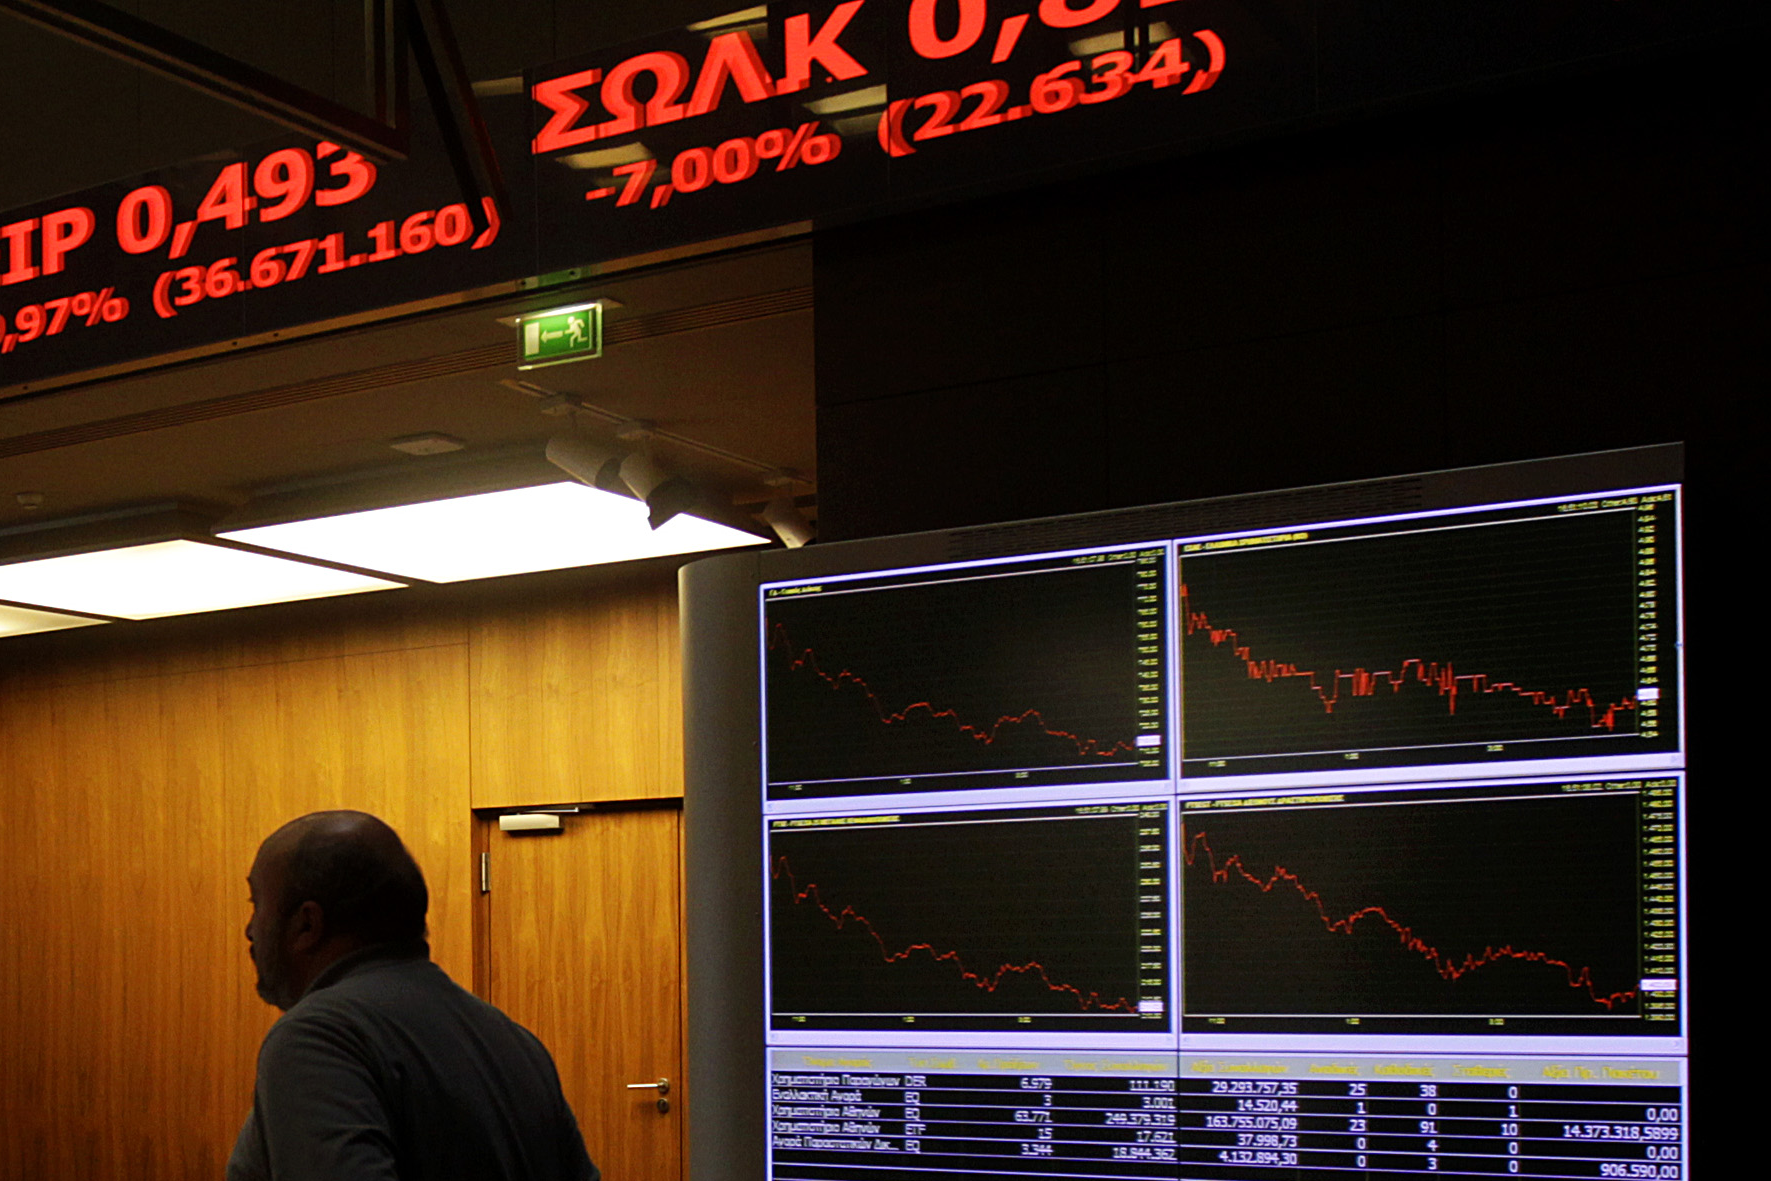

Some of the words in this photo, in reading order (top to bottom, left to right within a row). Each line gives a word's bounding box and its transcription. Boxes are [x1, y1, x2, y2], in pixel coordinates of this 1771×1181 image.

[585, 121, 842, 210] -7,00%
[877, 28, 1226, 158] (22.634)
[116, 140, 377, 260] 0,493
[152, 196, 501, 319] (36.671.160)
[1348, 1083, 1366, 1096] 25
[1419, 1085, 1437, 1098] 38
[1508, 1086, 1518, 1099] 0
[1357, 1102, 1366, 1114] 1
[1427, 1103, 1437, 1115] 0
[1509, 1105, 1518, 1118] 1
[1646, 1108, 1678, 1123] 0,00
[1348, 1119, 1366, 1132] 23
[1419, 1121, 1437, 1134] 91
[1501, 1123, 1518, 1136] 10
[1357, 1138, 1366, 1150] 0
[1508, 1142, 1518, 1155] 0
[1647, 1145, 1678, 1161] 0,00
[1357, 1155, 1366, 1168] 0
[1508, 1160, 1518, 1173] 0
